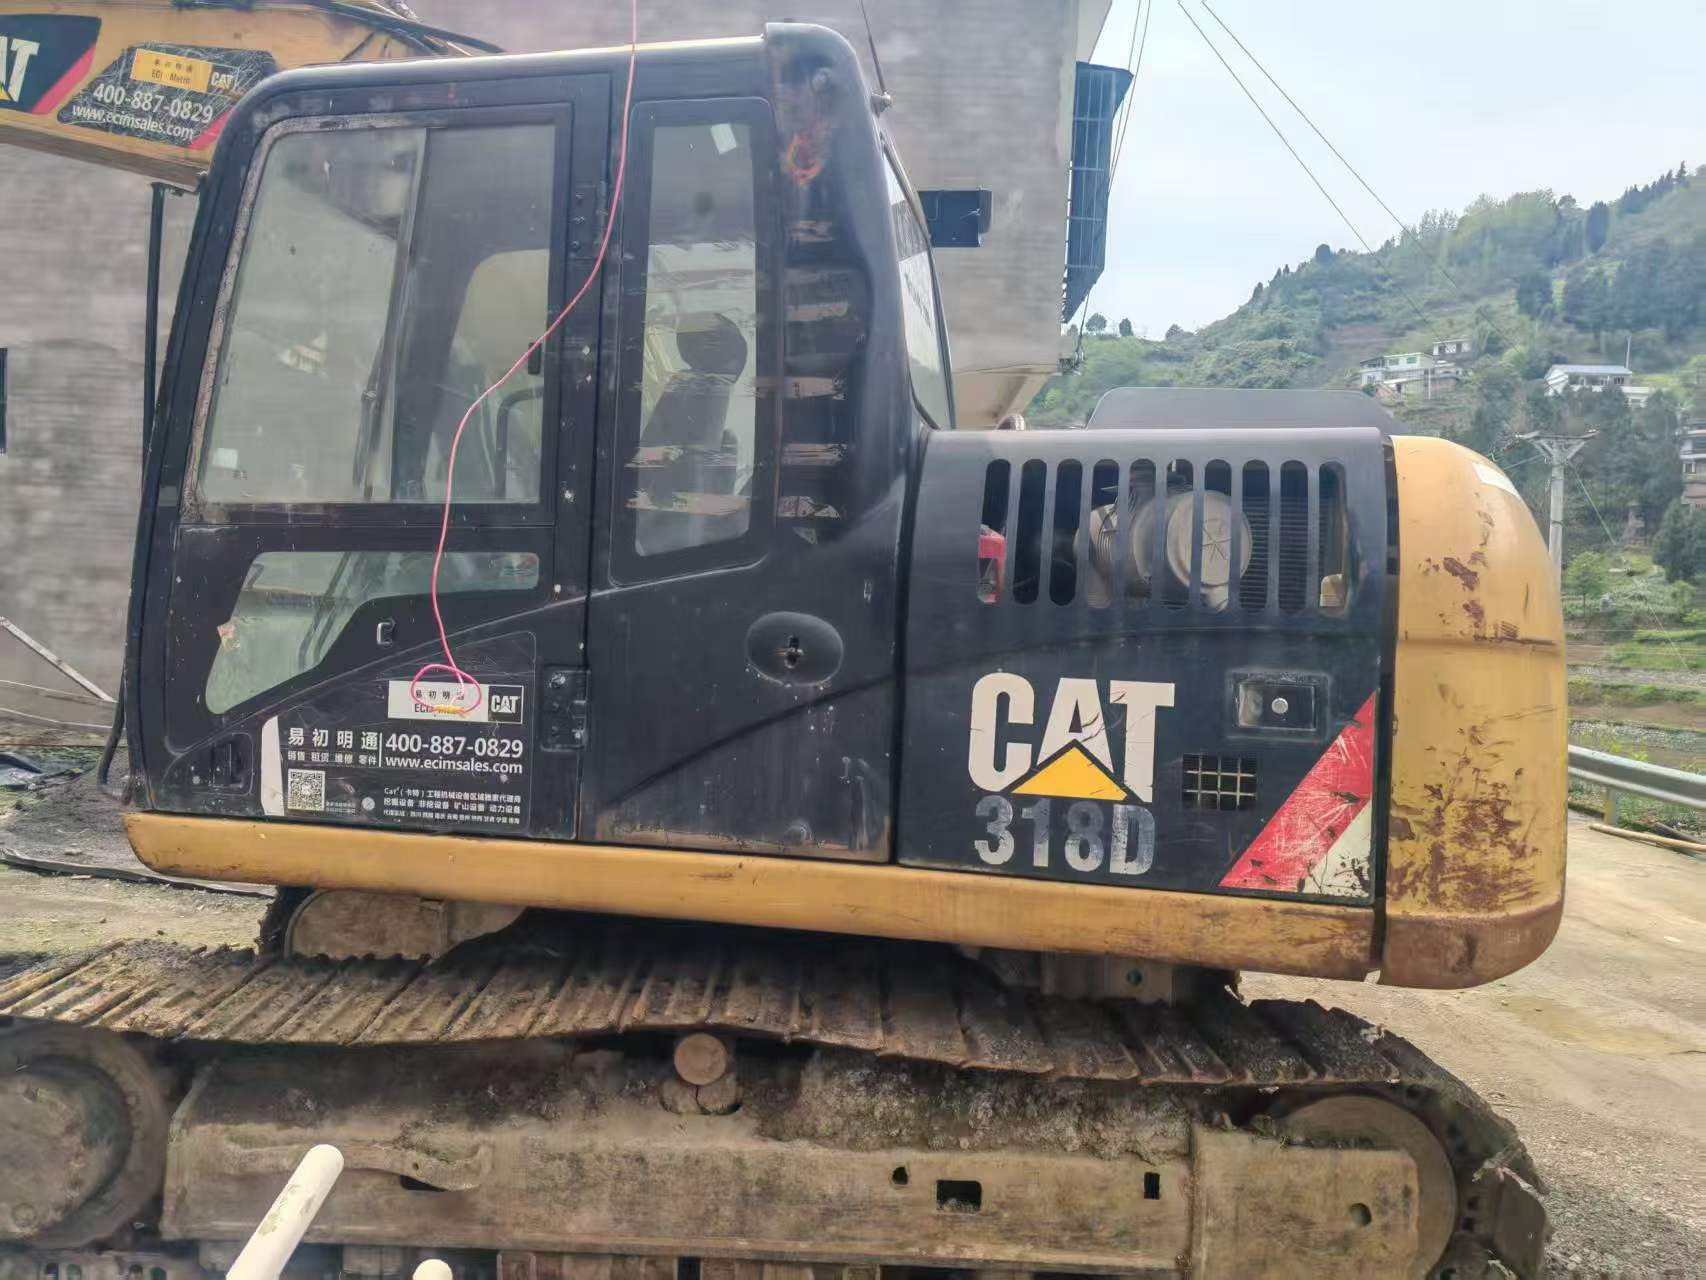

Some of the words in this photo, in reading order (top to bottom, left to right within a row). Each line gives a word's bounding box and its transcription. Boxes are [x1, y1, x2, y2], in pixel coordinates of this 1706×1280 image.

[211, 71, 235, 90] CAT
[93, 83, 213, 124] 400-887-0829
[71, 105, 195, 141] www.ecimsales.com
[491, 694, 520, 713] CAT
[288, 727, 378, 750] 易初明通
[385, 733, 523, 758] 400-887-0829
[968, 672, 1176, 803] CAT
[359, 754, 377, 766] 零件
[385, 756, 523, 774] www.ecimsales.com
[974, 795, 1156, 876] 318D
